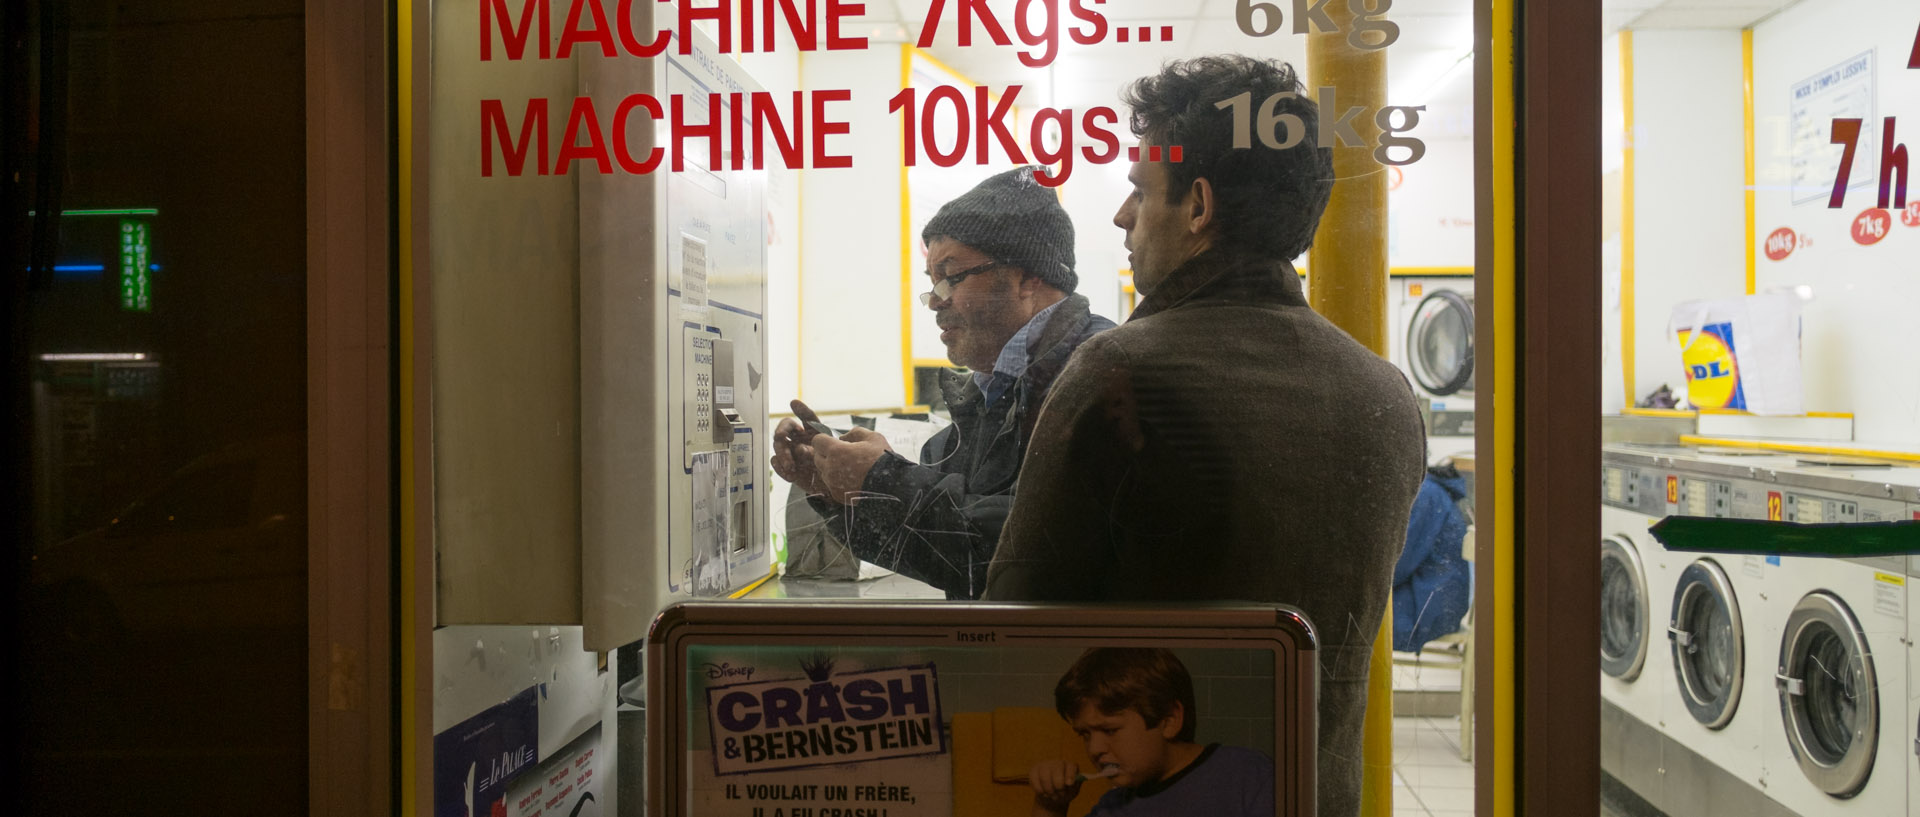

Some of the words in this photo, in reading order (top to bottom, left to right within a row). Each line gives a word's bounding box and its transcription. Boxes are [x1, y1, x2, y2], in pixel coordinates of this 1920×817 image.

[480, 0, 868, 61] MACHINE
[1234, 0, 1400, 50] 6kg
[1842, 57, 1867, 80] LESSIVE
[481, 90, 853, 177] MACHINE
[889, 85, 1183, 187] 10Kgs...
[1214, 86, 1427, 166] 16kg
[1858, 215, 1884, 239] 7kg
[1767, 231, 1793, 254] 10kg
[1768, 496, 1782, 521] 12
[717, 675, 930, 732] CRASH
[726, 784, 741, 799] IL
[746, 784, 818, 800] VOULAIT
[825, 785, 847, 800] UN
[855, 782, 916, 805] FRÈRE,
[775, 808, 785, 817] A
[819, 808, 878, 817] CRASH
